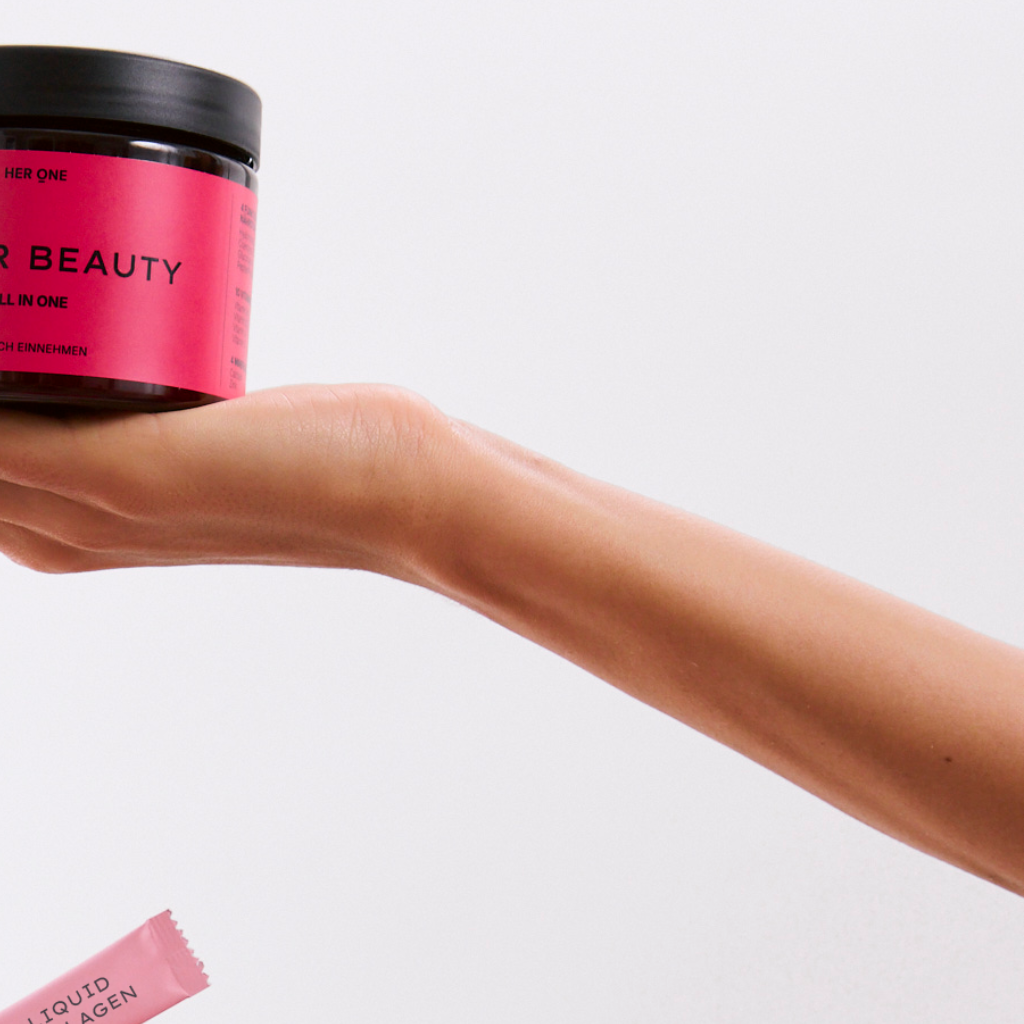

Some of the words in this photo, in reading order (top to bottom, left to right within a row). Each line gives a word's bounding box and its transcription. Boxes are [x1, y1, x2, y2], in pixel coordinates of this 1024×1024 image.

[4, 167, 33, 180] HER
[36, 168, 68, 183] ONE
[29, 245, 182, 285] BEAUTY
[18, 294, 34, 307] IN
[36, 294, 68, 309] ONE
[17, 341, 88, 357] EINNEHMEN
